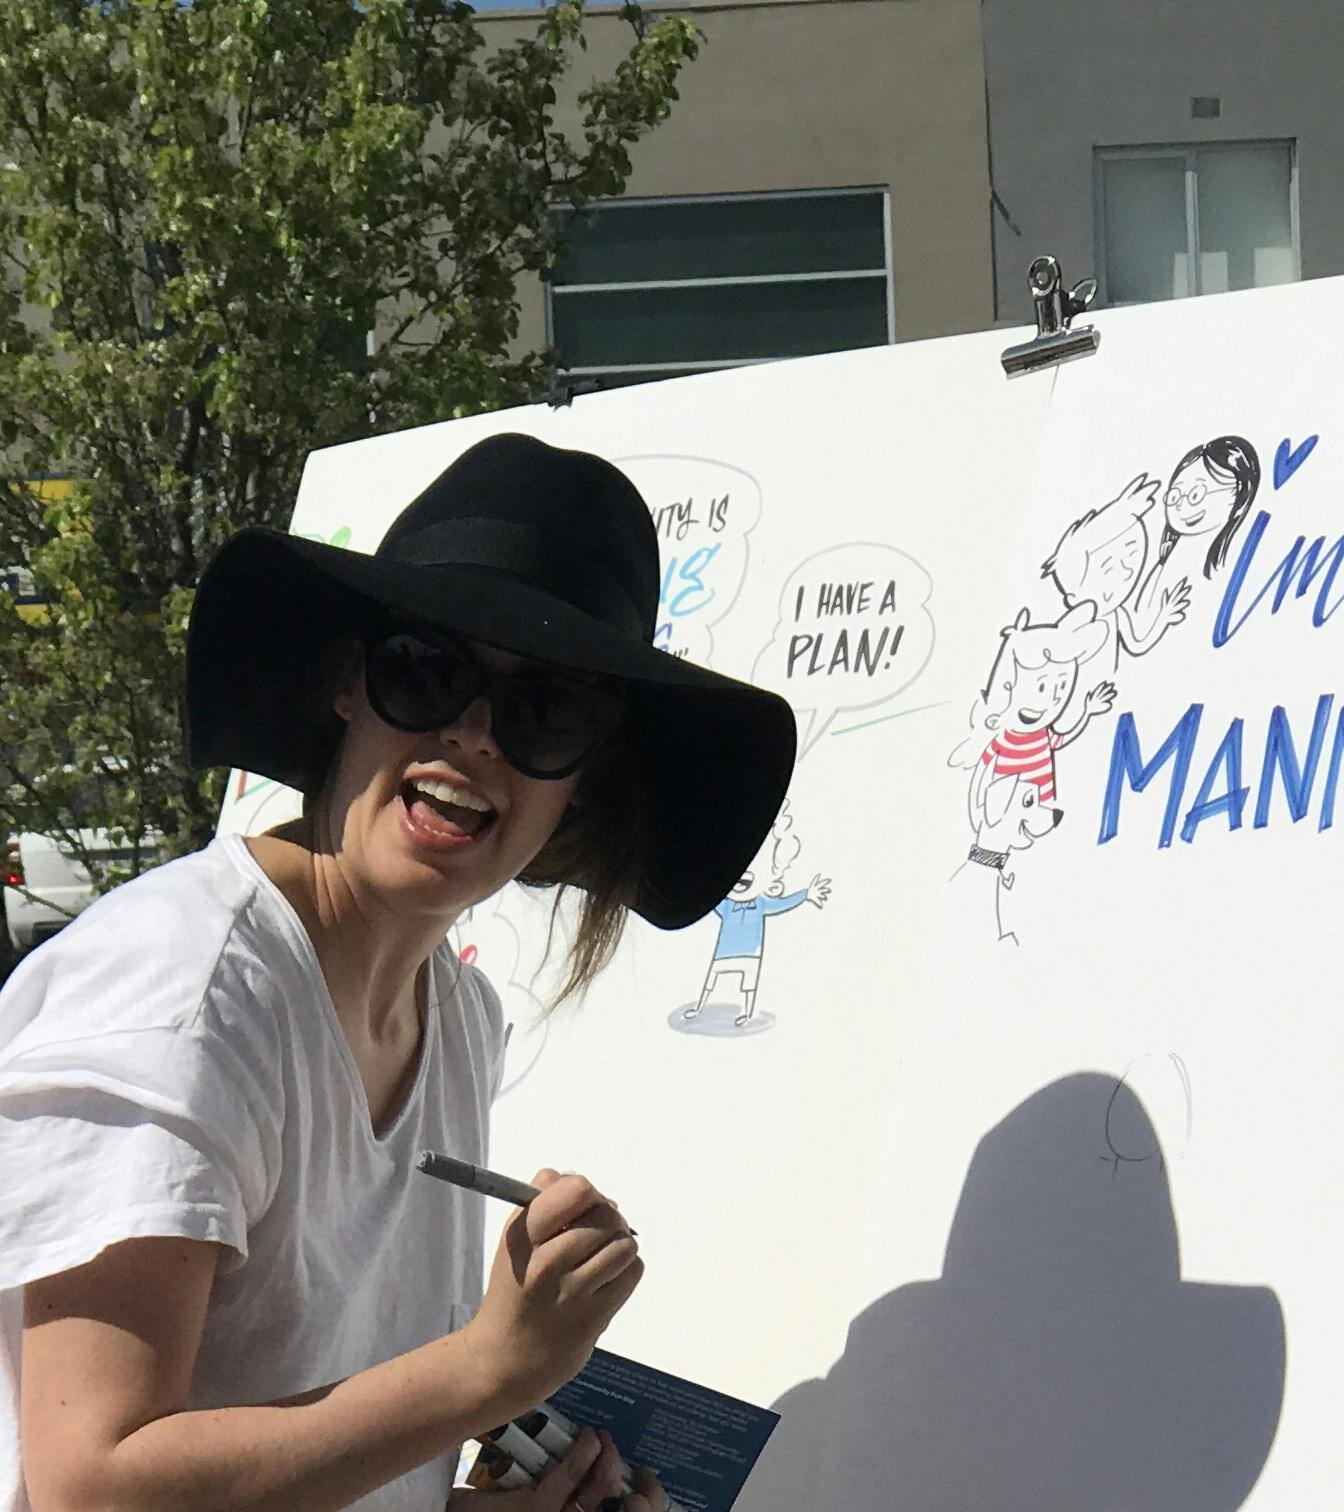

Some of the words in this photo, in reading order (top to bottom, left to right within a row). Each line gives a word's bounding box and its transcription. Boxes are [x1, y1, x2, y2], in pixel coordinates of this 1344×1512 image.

[708, 493, 730, 533] IS
[794, 584, 805, 623] I
[816, 580, 875, 619] HAVE
[878, 579, 897, 616] A
[786, 624, 905, 680] PLAN!
